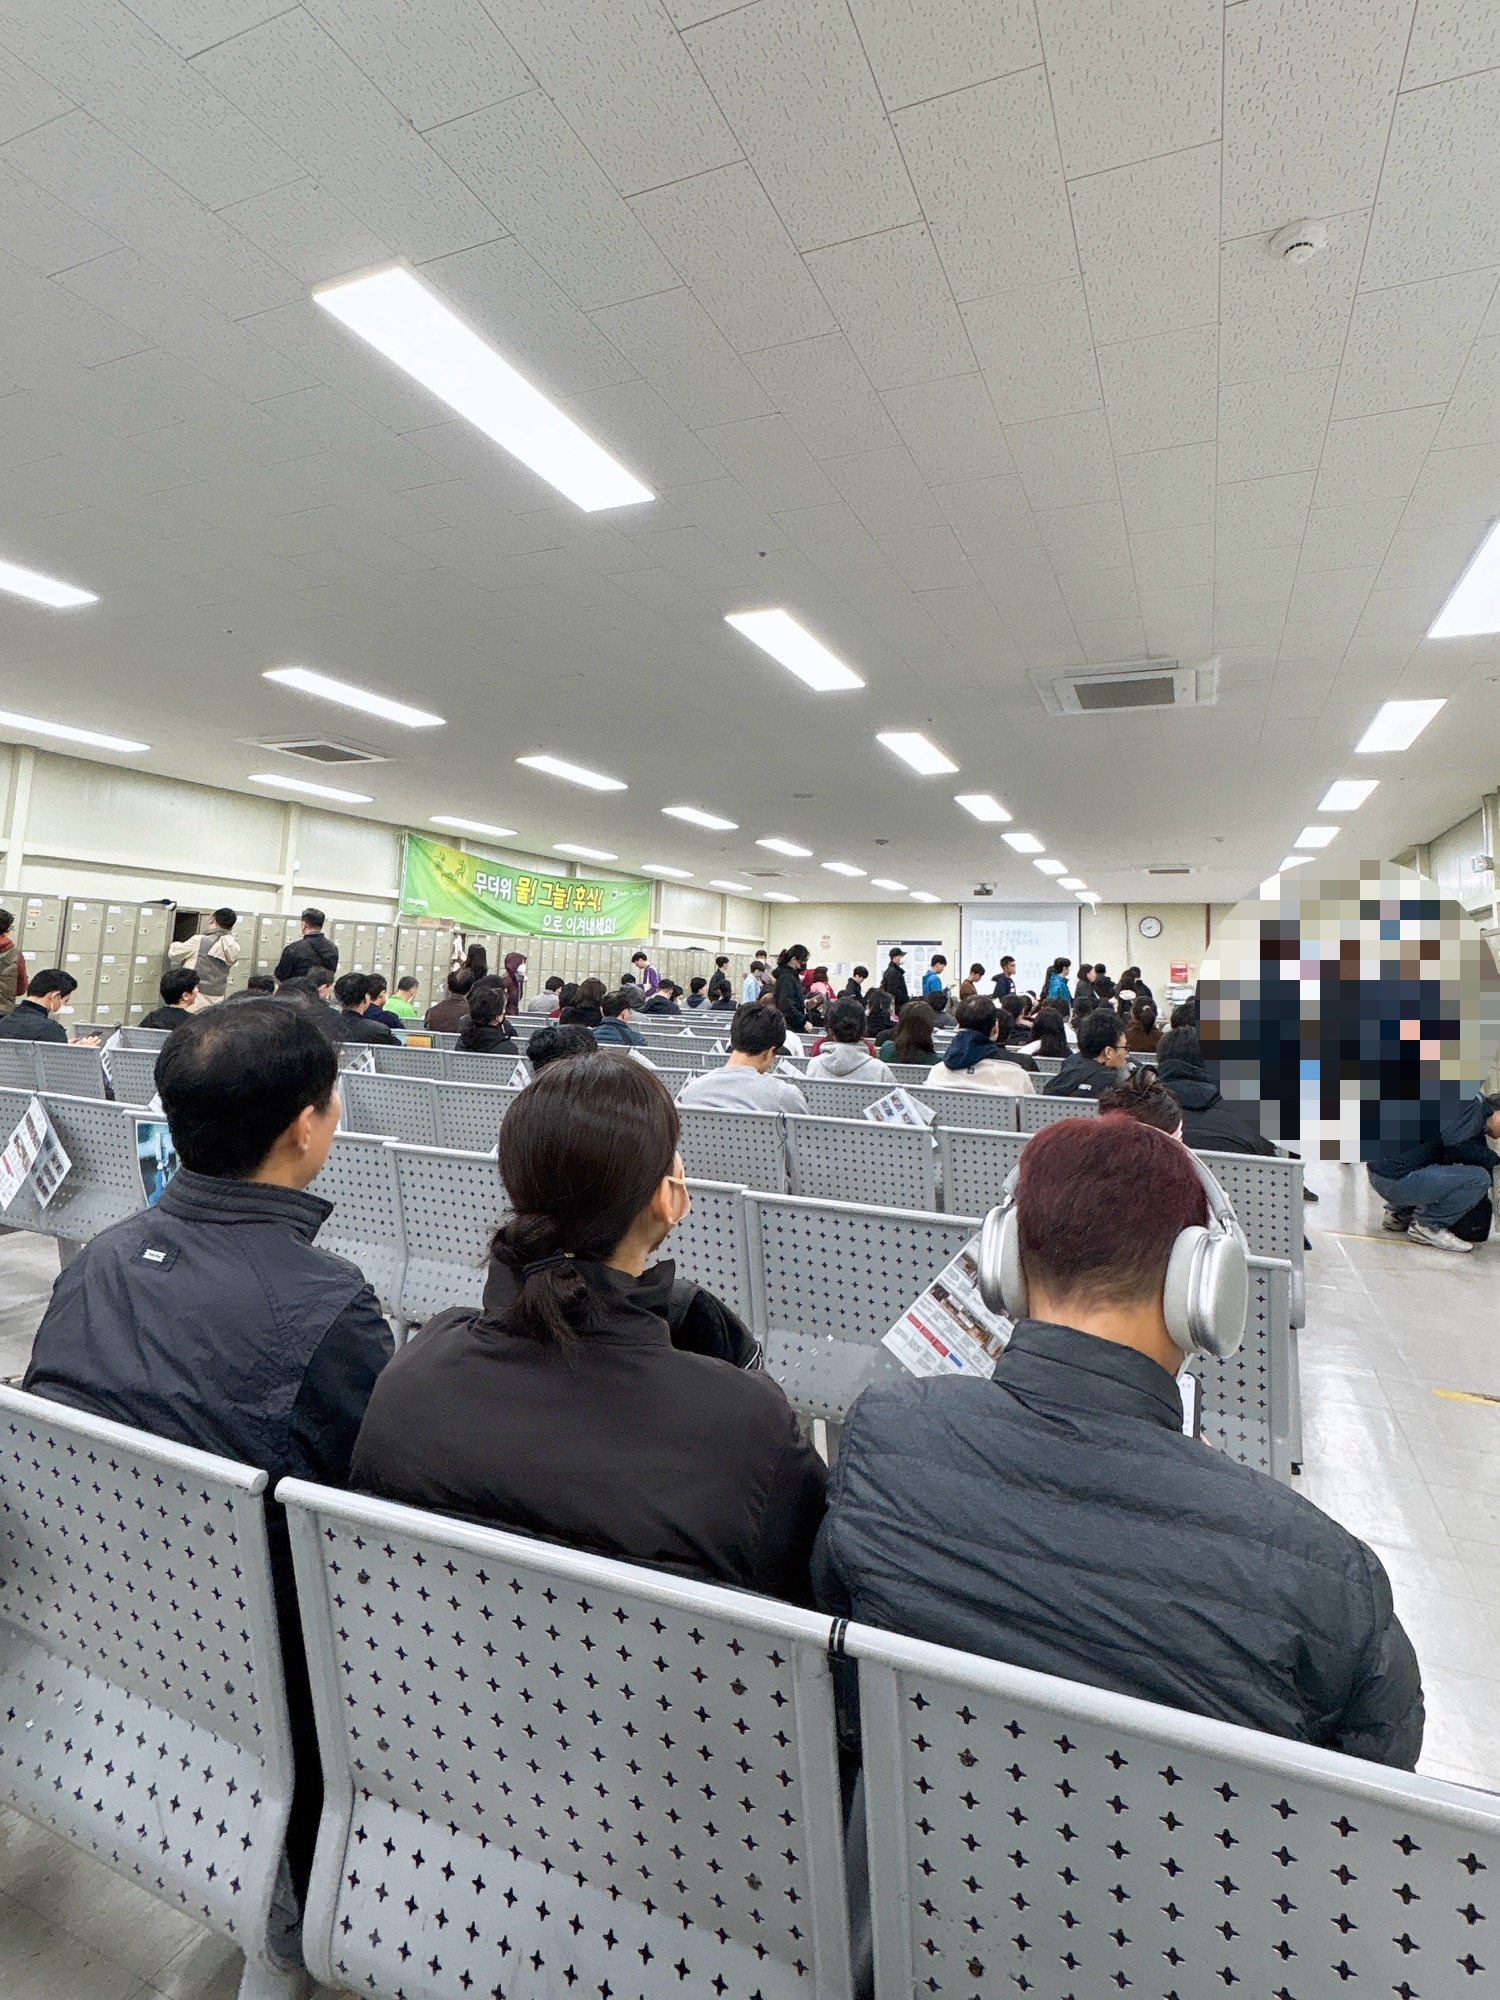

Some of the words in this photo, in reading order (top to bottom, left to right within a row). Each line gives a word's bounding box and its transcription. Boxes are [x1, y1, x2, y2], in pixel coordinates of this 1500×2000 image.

[473, 871, 512, 901] 무더위
[515, 876, 538, 905] 물!
[537, 881, 573, 910] 그늘!
[573, 884, 604, 912] 휴식!
[541, 914, 563, 933] 으로
[566, 916, 616, 936] 이겨내세요!
